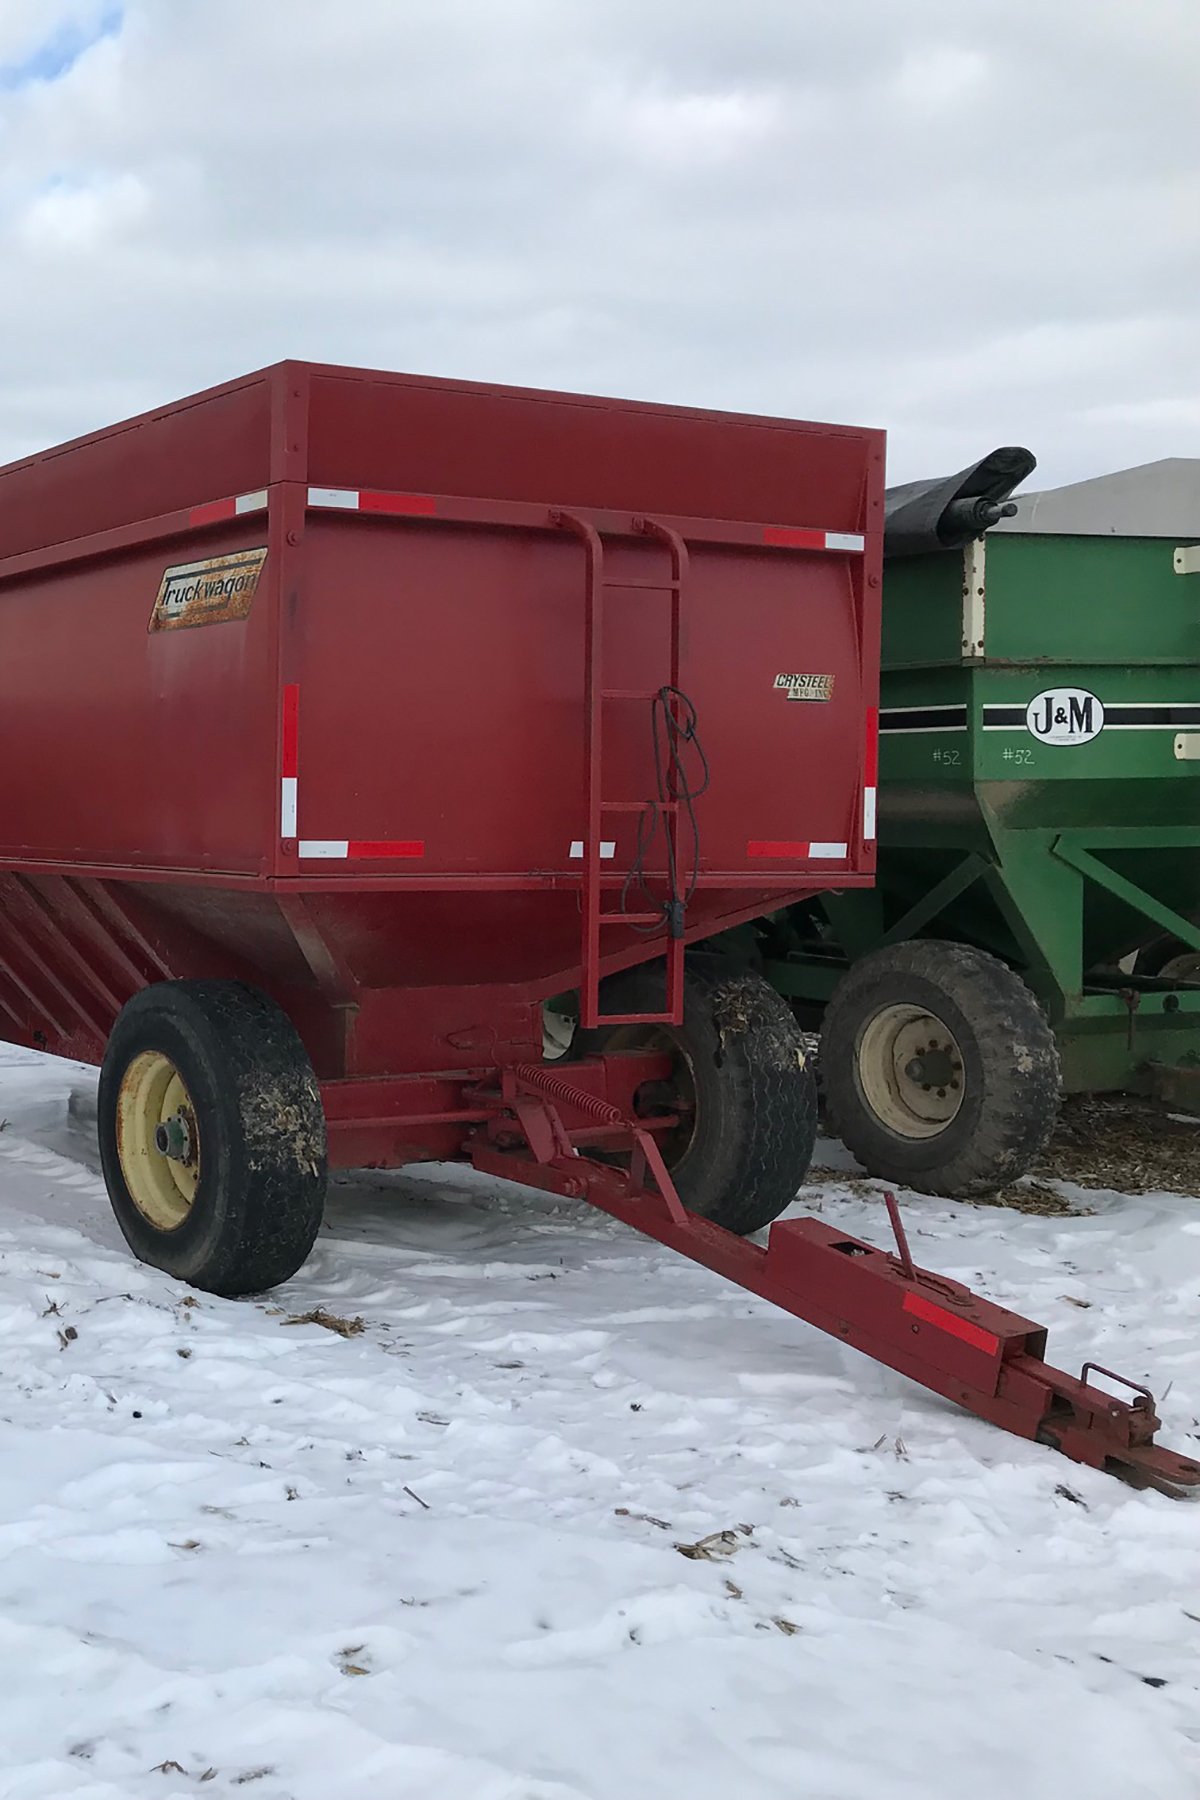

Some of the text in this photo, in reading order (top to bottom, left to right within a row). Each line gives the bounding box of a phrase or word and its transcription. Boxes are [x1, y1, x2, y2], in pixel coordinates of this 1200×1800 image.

[777, 674, 830, 688] CRYSTEEL
[1032, 696, 1094, 734] J&M
[932, 748, 962, 765] #52
[1002, 748, 1035, 765] #52
